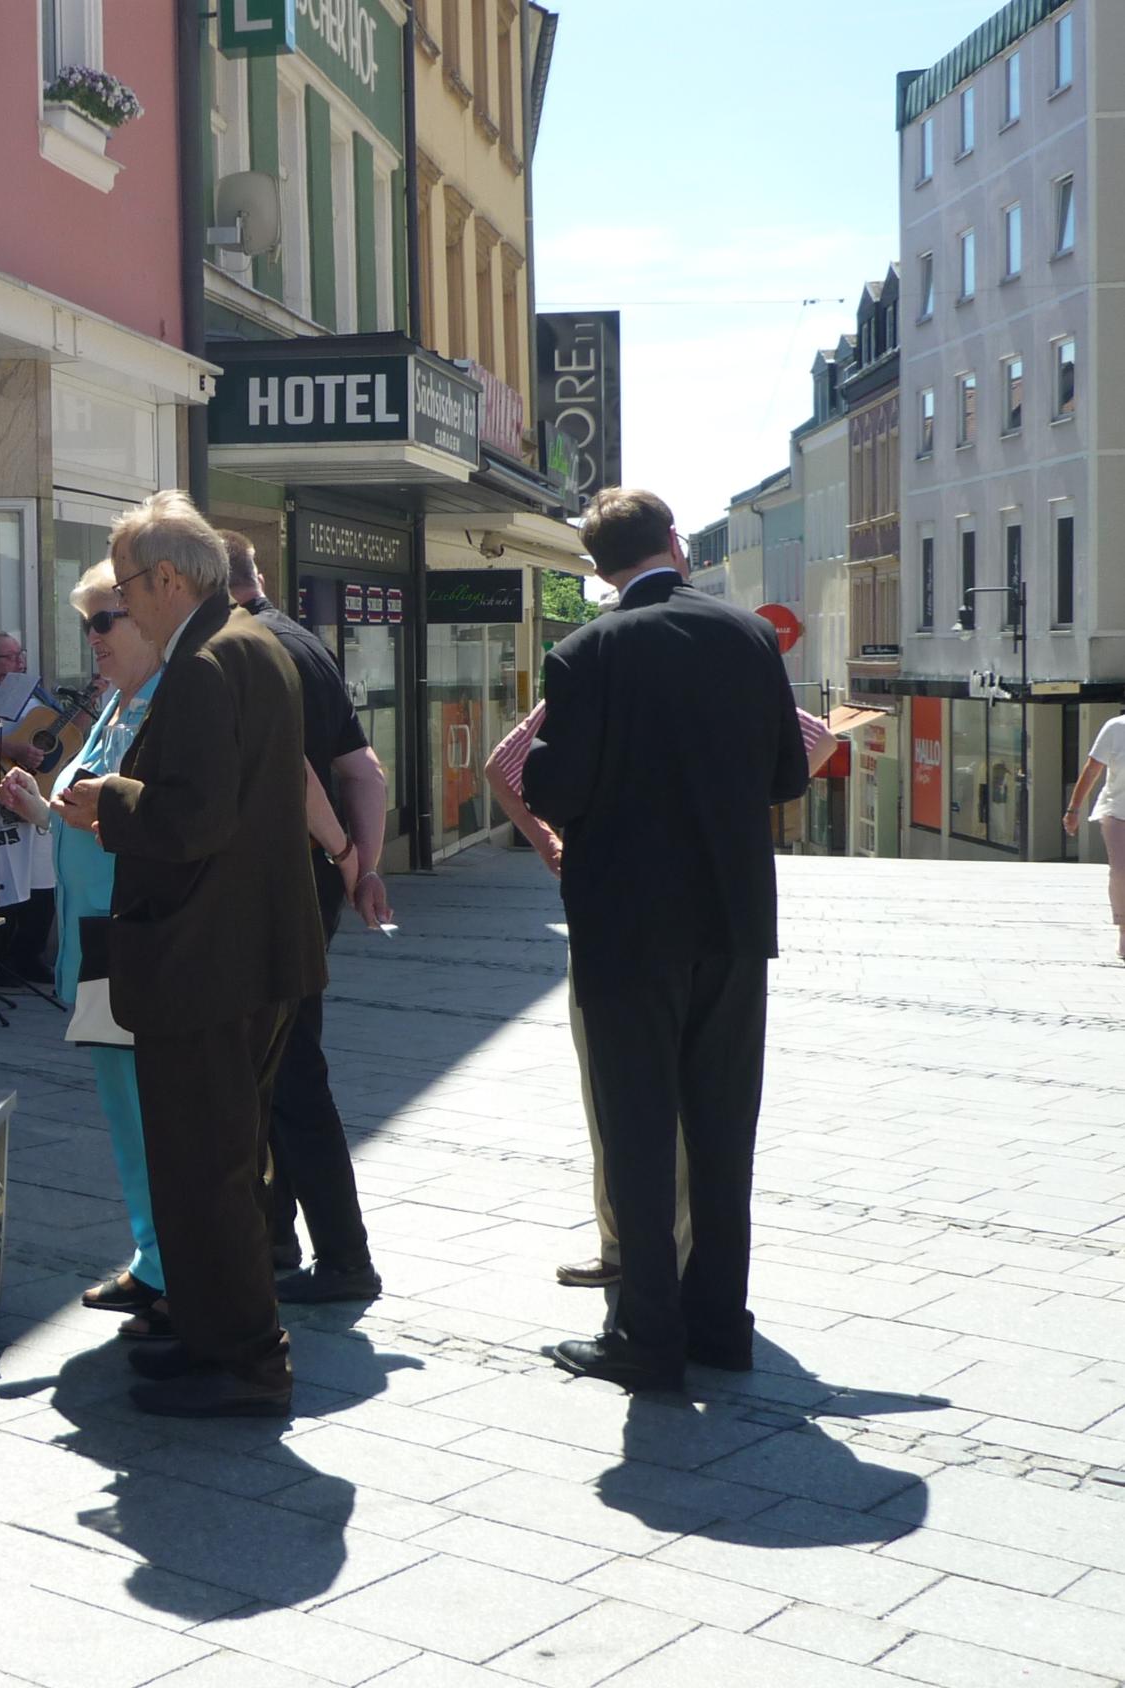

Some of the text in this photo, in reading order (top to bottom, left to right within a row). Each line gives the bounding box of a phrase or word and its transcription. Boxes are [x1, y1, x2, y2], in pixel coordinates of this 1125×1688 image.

[248, 374, 400, 426] HOTEL
[416, 367, 461, 431] Sächsischer
[435, 428, 460, 453] GARAGEN
[914, 738, 941, 767] HALLO
